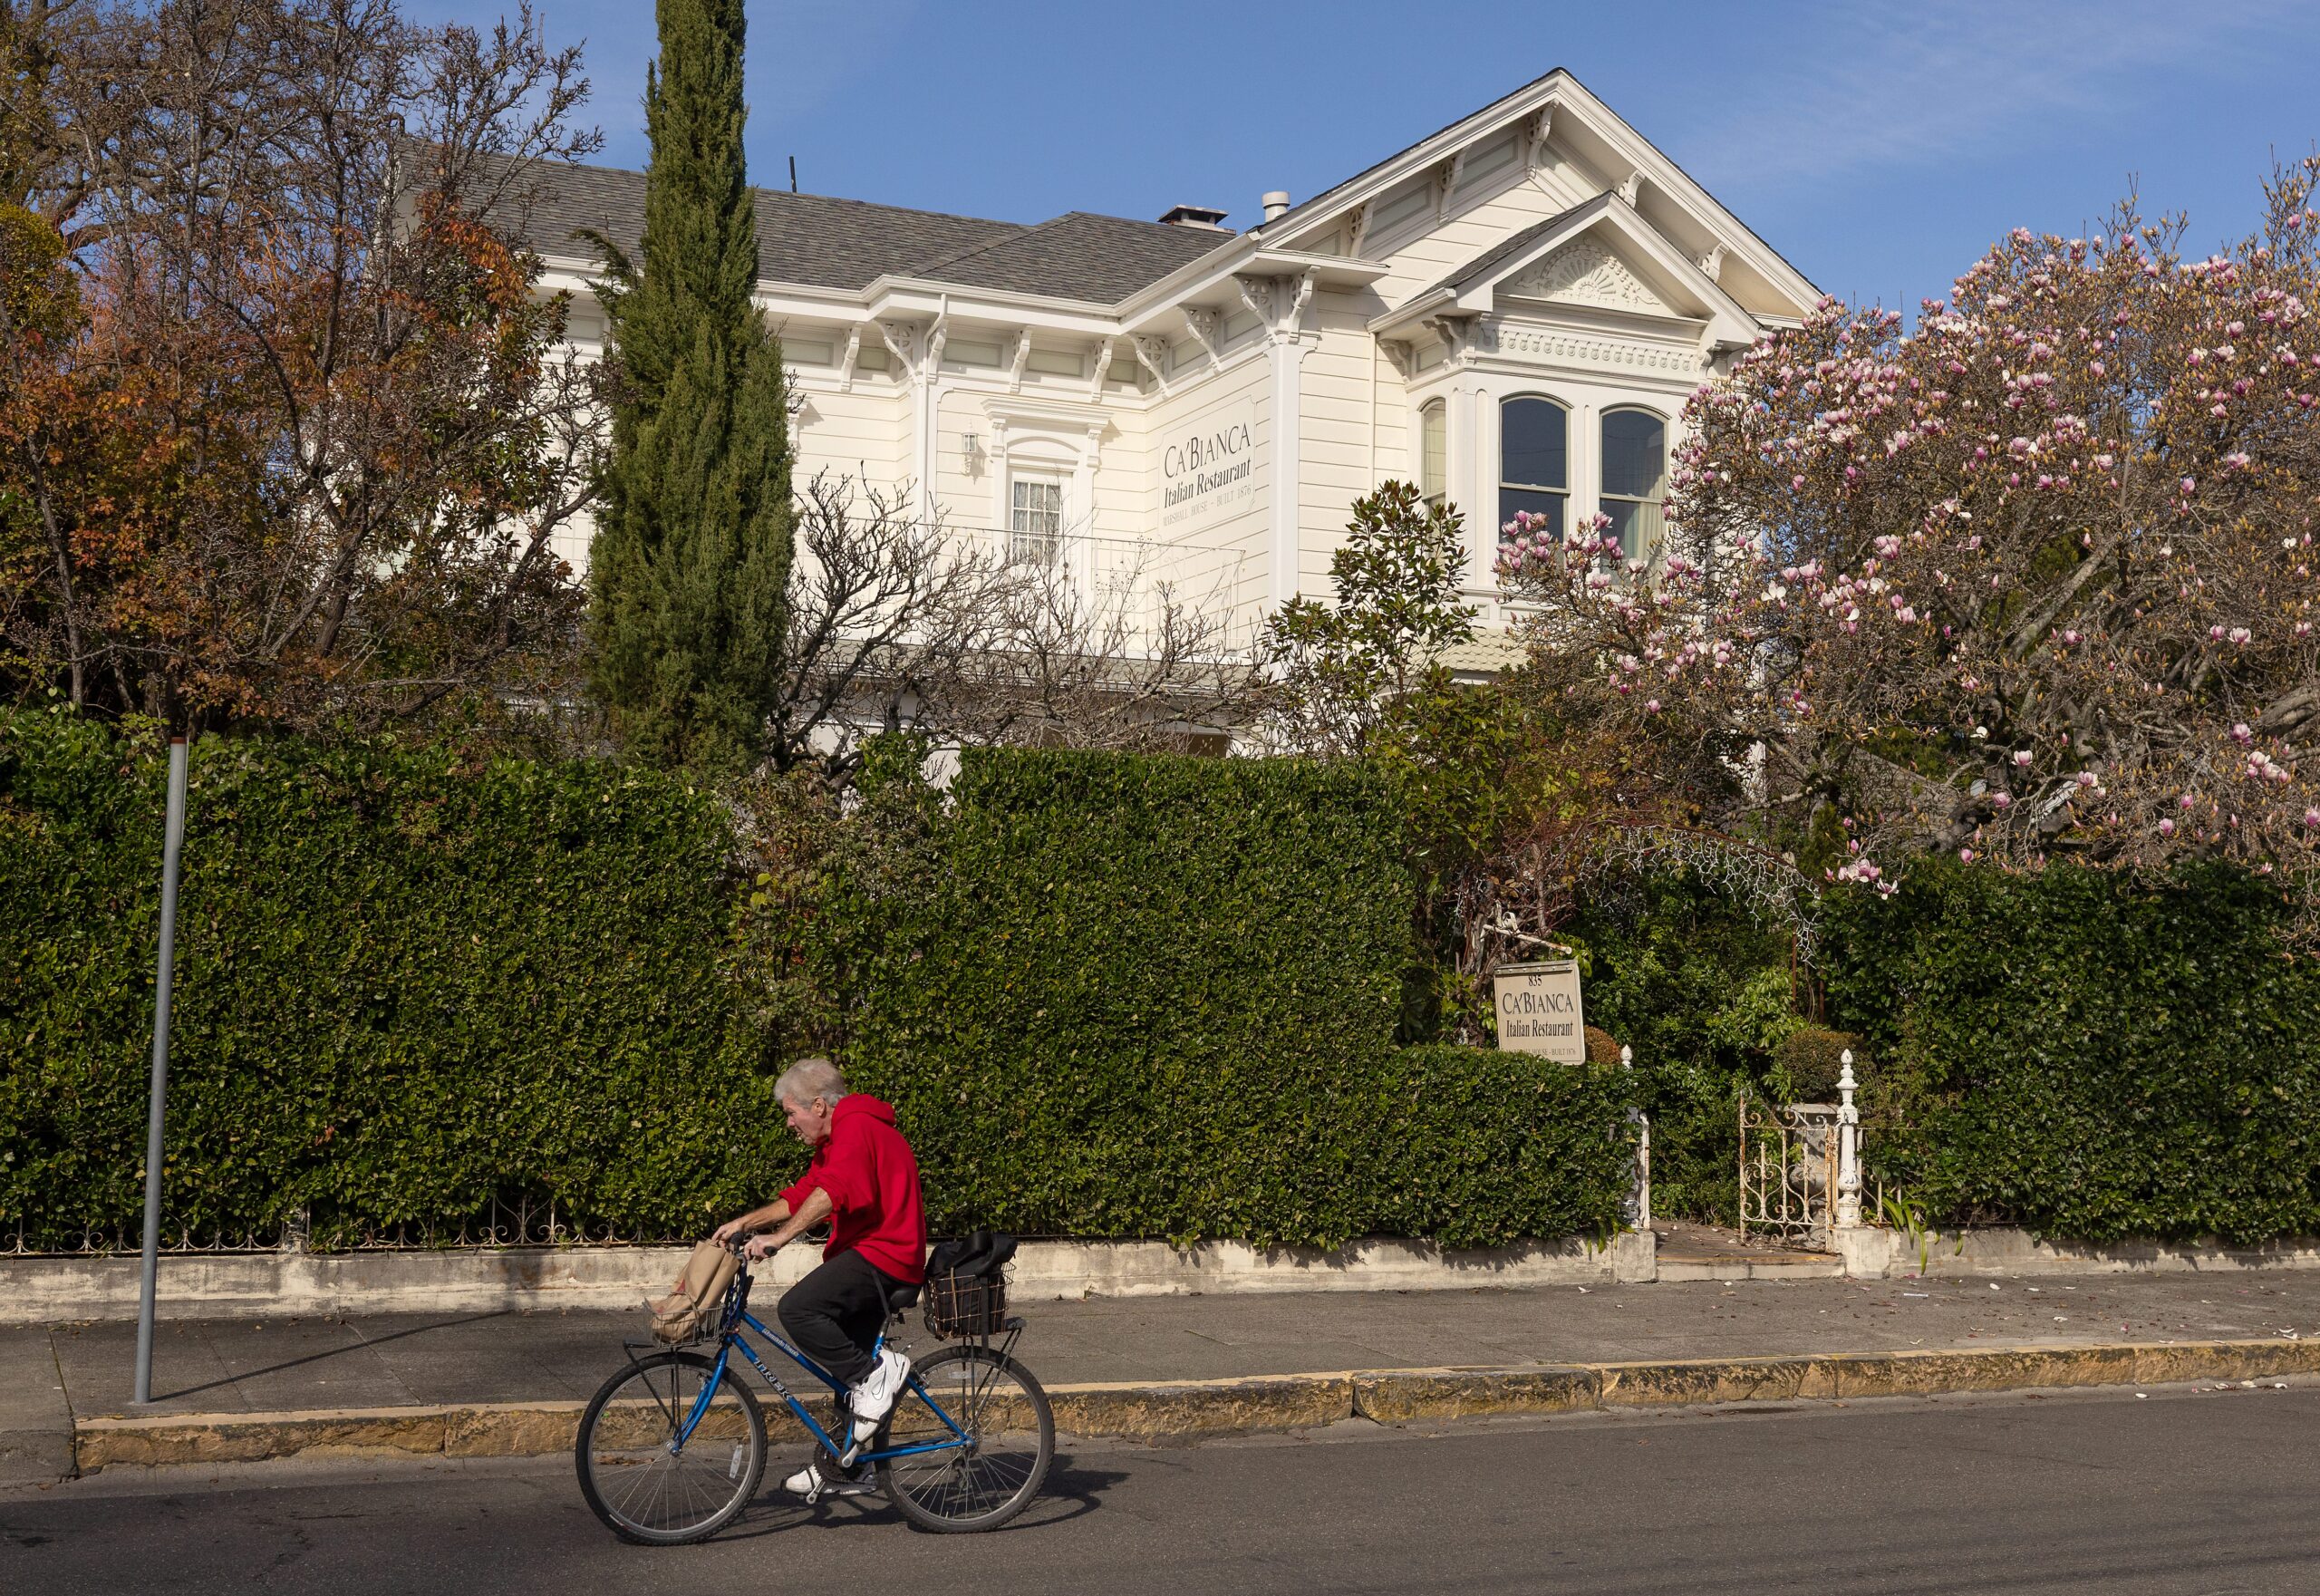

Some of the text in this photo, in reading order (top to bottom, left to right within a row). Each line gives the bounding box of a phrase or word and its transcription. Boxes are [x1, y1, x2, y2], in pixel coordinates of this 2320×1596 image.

[1165, 422, 1251, 479] CA'BIANCA
[1164, 456, 1251, 508] Italian Restaurant
[1216, 490, 1233, 508] BUILT
[1528, 974, 1542, 987] 835
[1502, 991, 1574, 1014] CA'BIANCA
[1506, 1019, 1574, 1038] Italian Restaurant
[1552, 1048, 1565, 1056] BUILT
[753, 1357, 794, 1401] TREK
